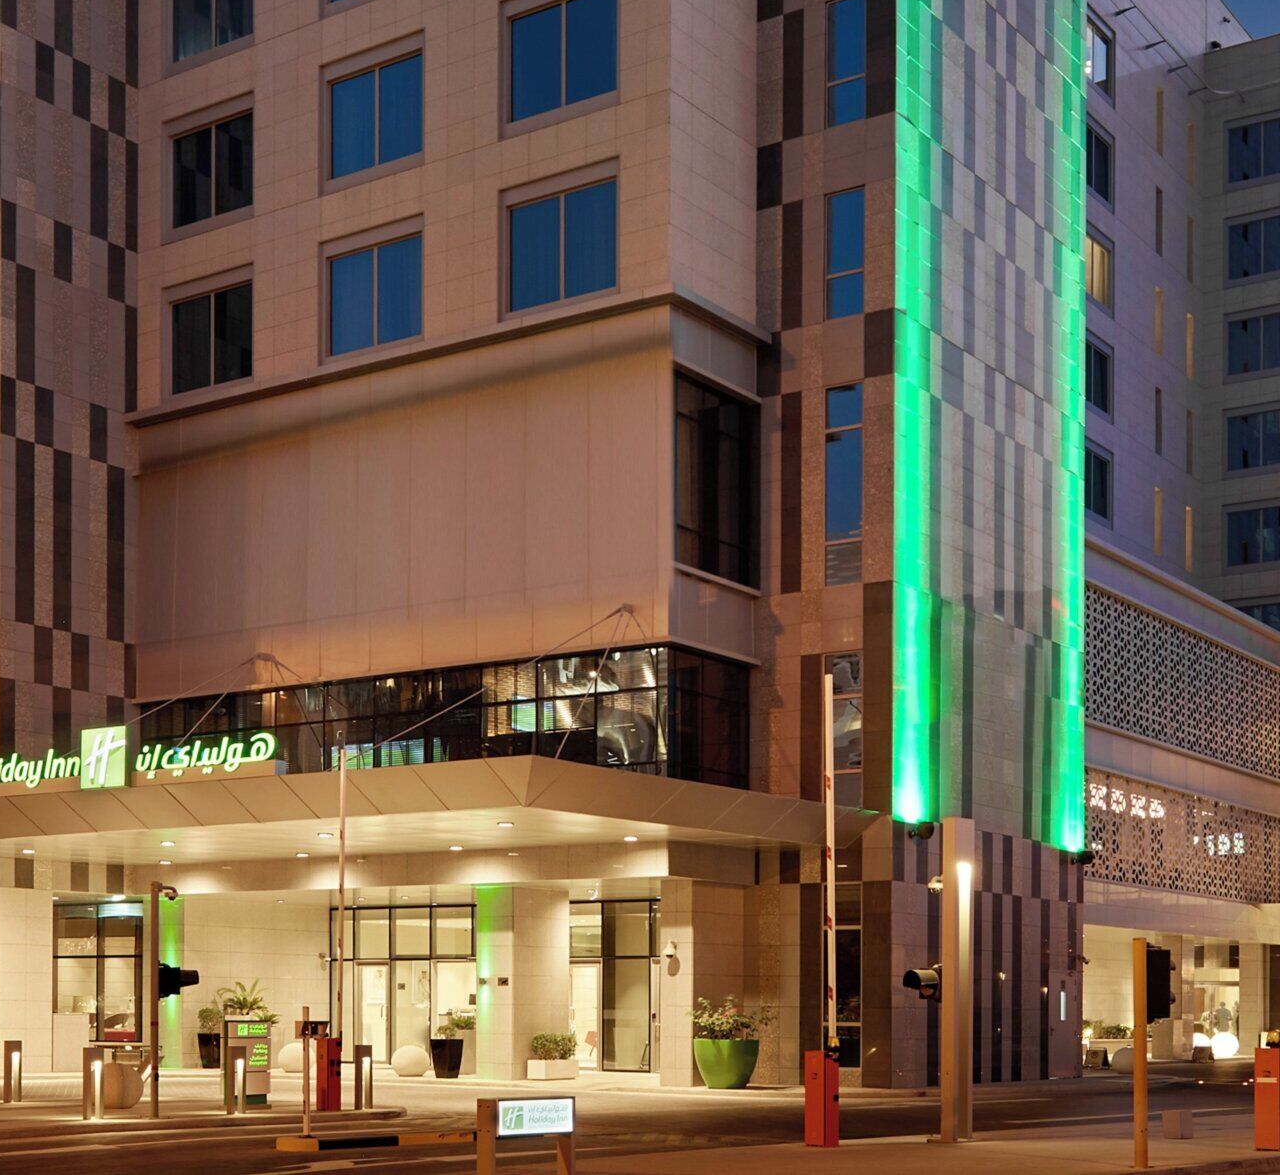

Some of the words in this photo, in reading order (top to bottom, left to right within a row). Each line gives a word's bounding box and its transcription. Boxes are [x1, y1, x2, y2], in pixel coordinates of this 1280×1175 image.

[44, 748, 81, 779] Inn
[528, 1113, 556, 1124] Holiday
[556, 1113, 569, 1123] Inn
